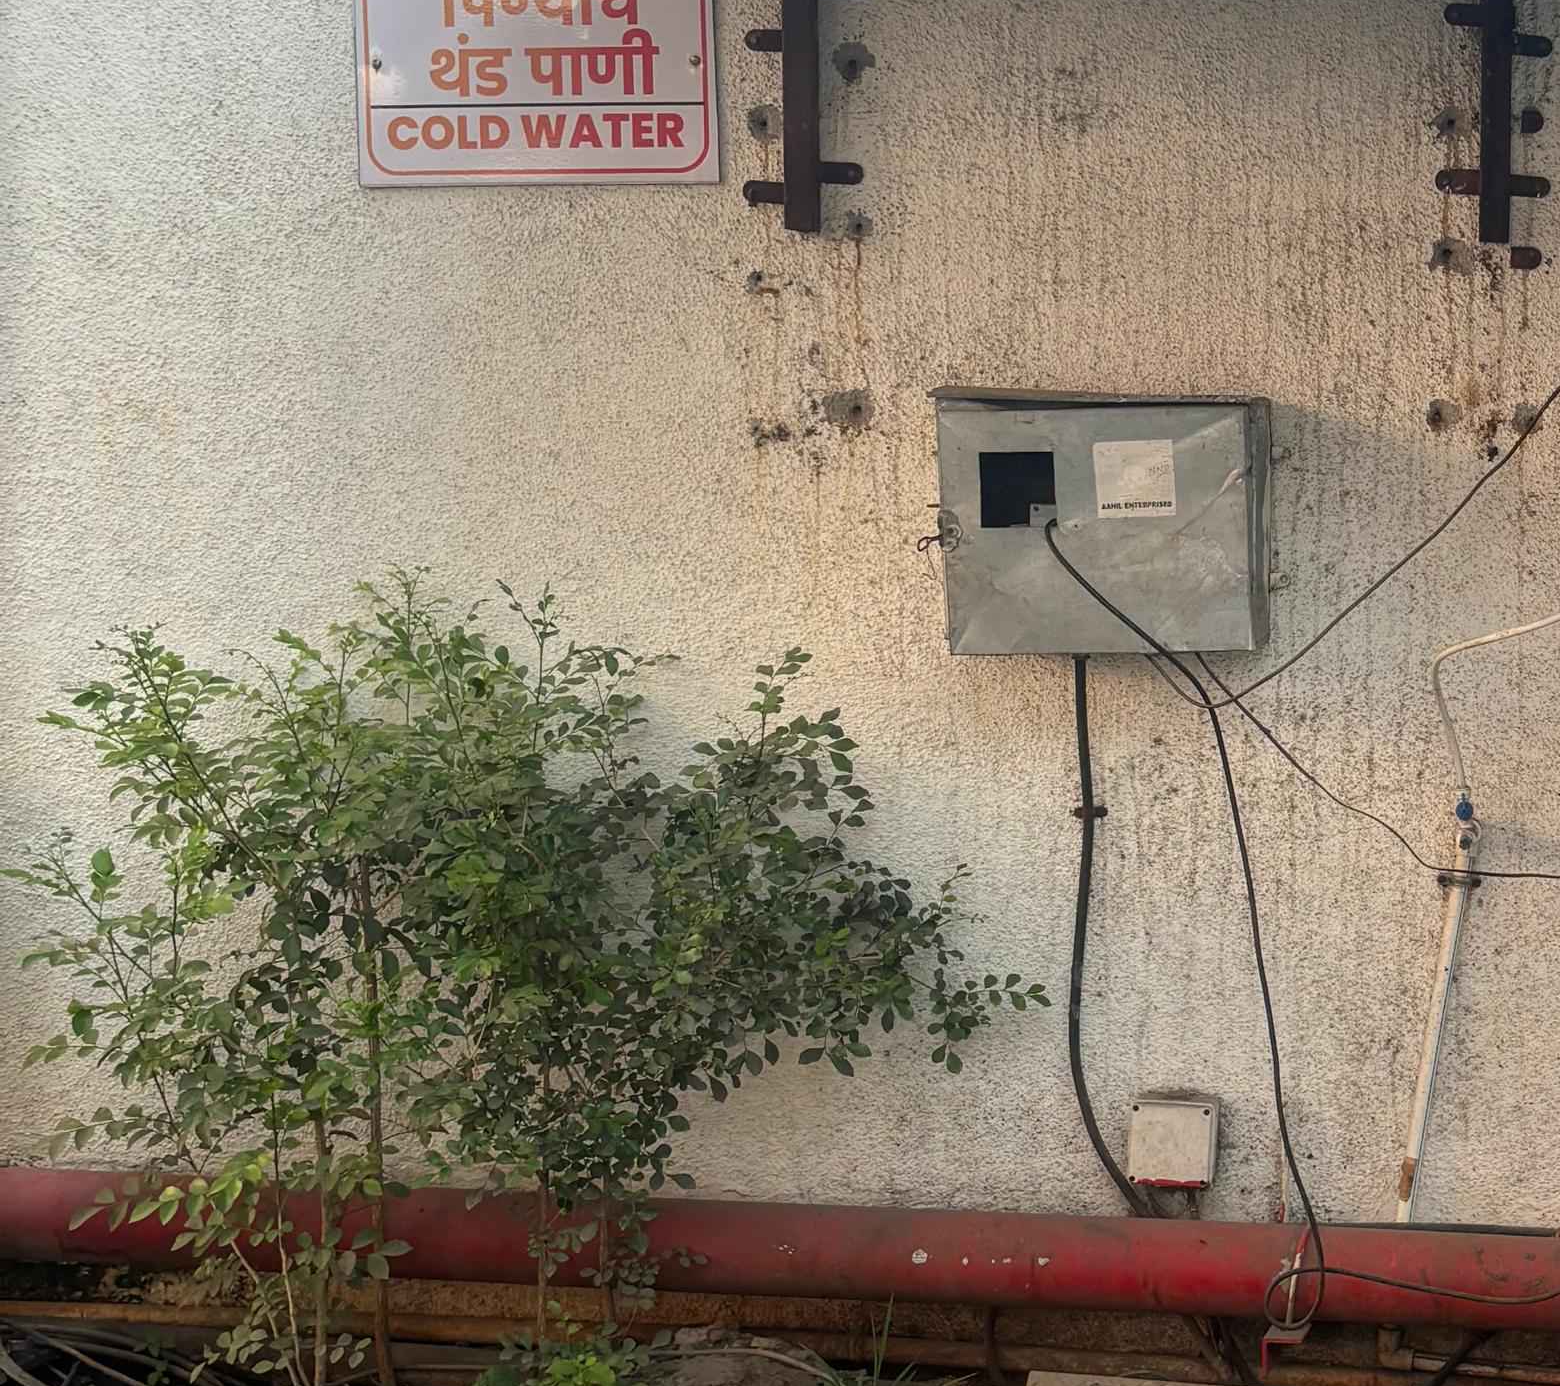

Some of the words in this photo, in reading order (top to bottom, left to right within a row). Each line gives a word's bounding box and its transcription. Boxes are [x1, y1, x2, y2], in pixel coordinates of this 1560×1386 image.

[429, 33, 512, 97] थंड
[524, 28, 660, 96] पाणी
[388, 115, 509, 150] COLD
[521, 113, 684, 150] WATER
